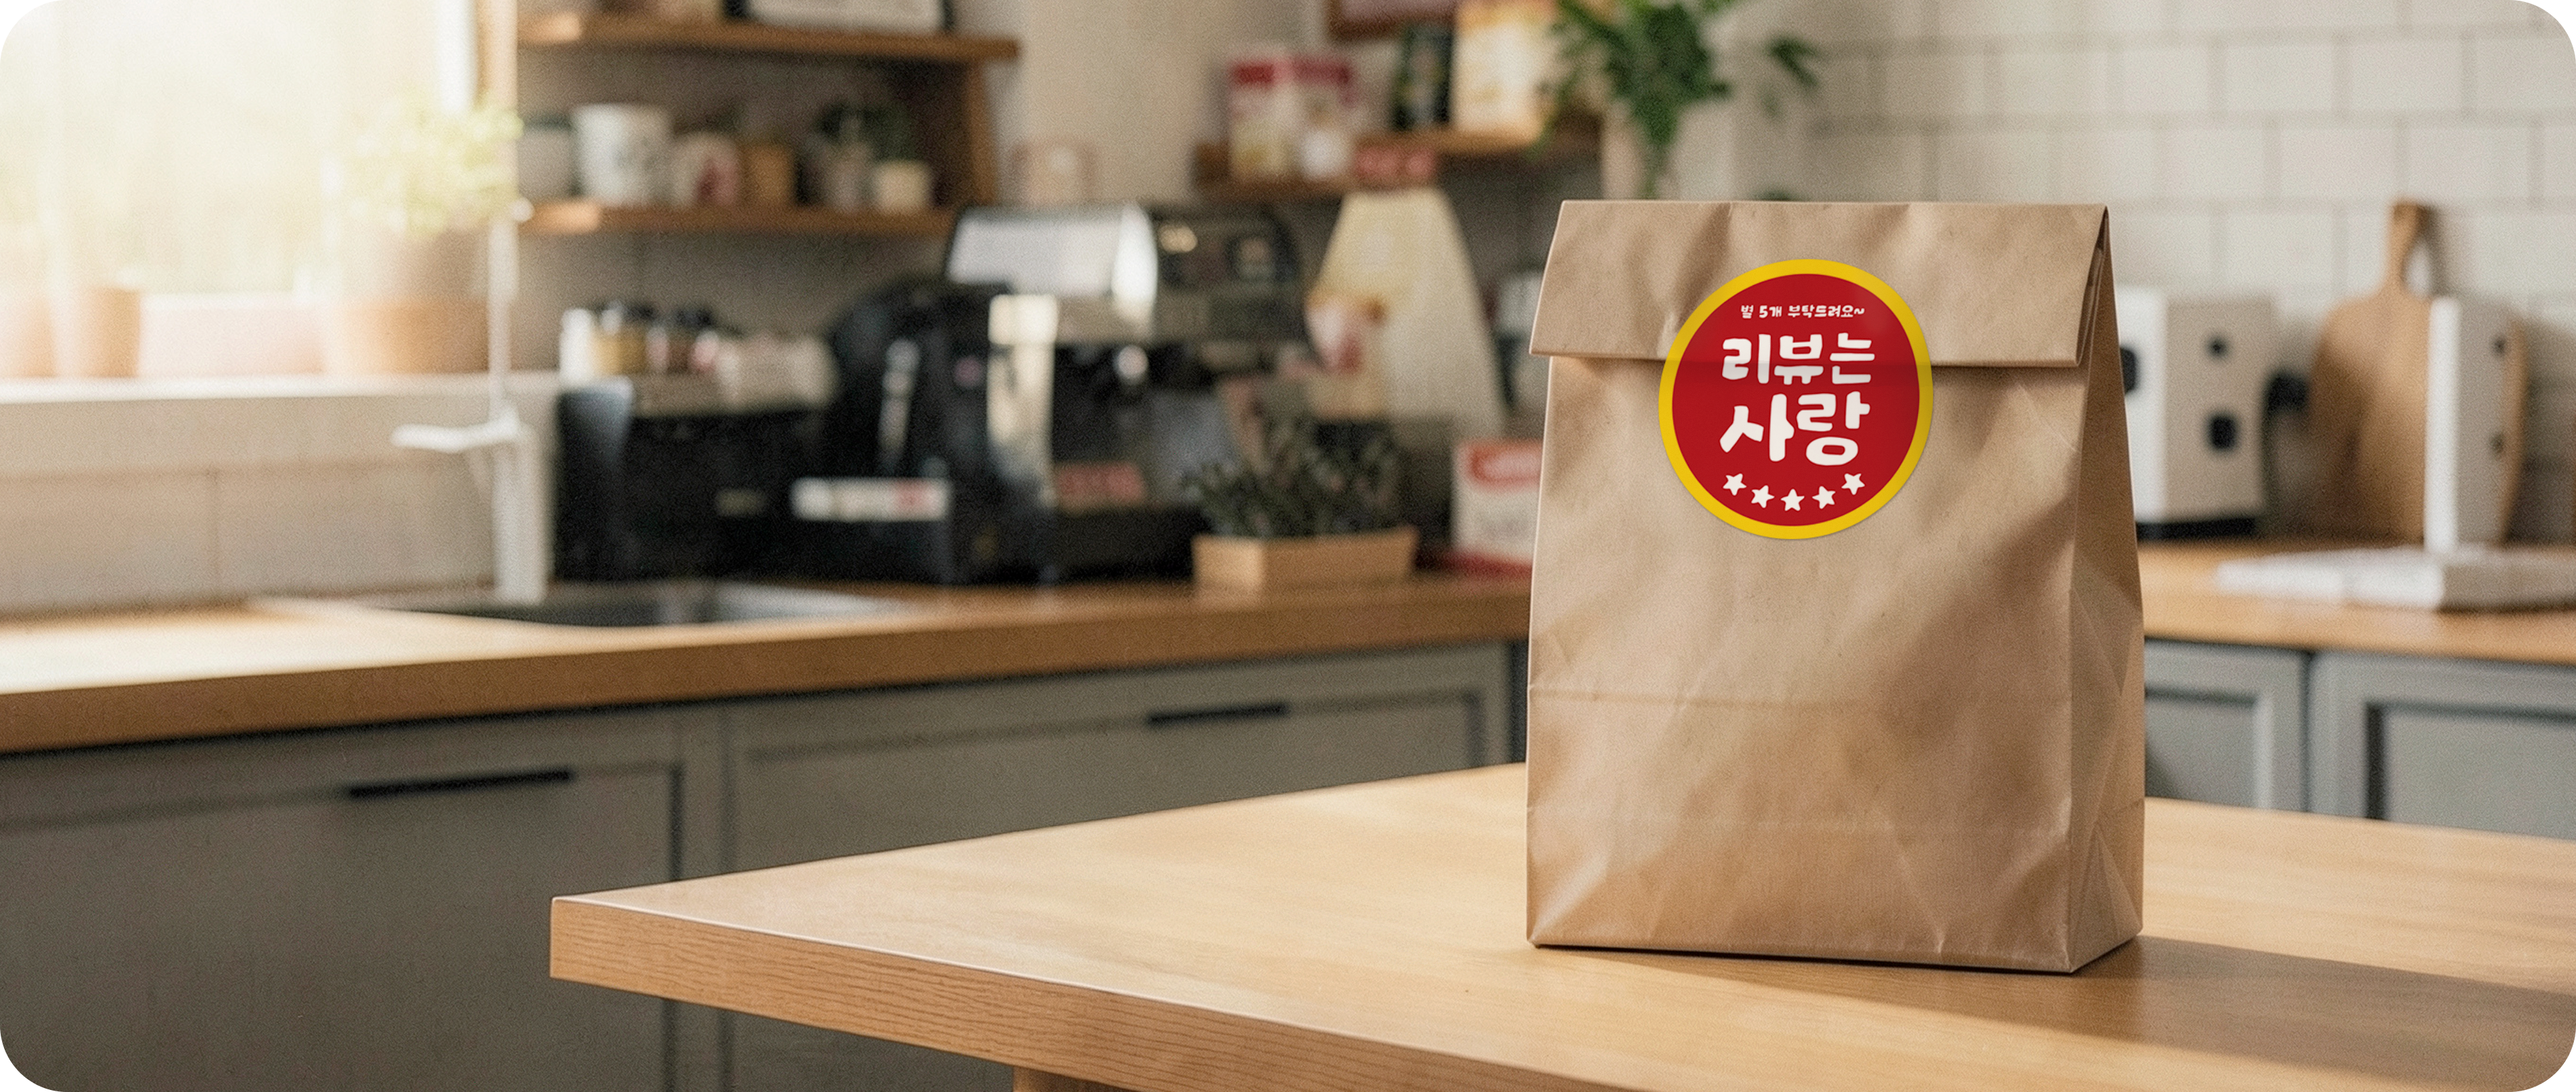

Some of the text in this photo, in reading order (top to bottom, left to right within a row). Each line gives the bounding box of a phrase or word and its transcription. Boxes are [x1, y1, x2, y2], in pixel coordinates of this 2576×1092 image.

[1741, 305, 1865, 319] 별 5개 부탁드려요~
[1721, 332, 1875, 385] 리뷰는
[1719, 391, 1870, 466] 사랑
